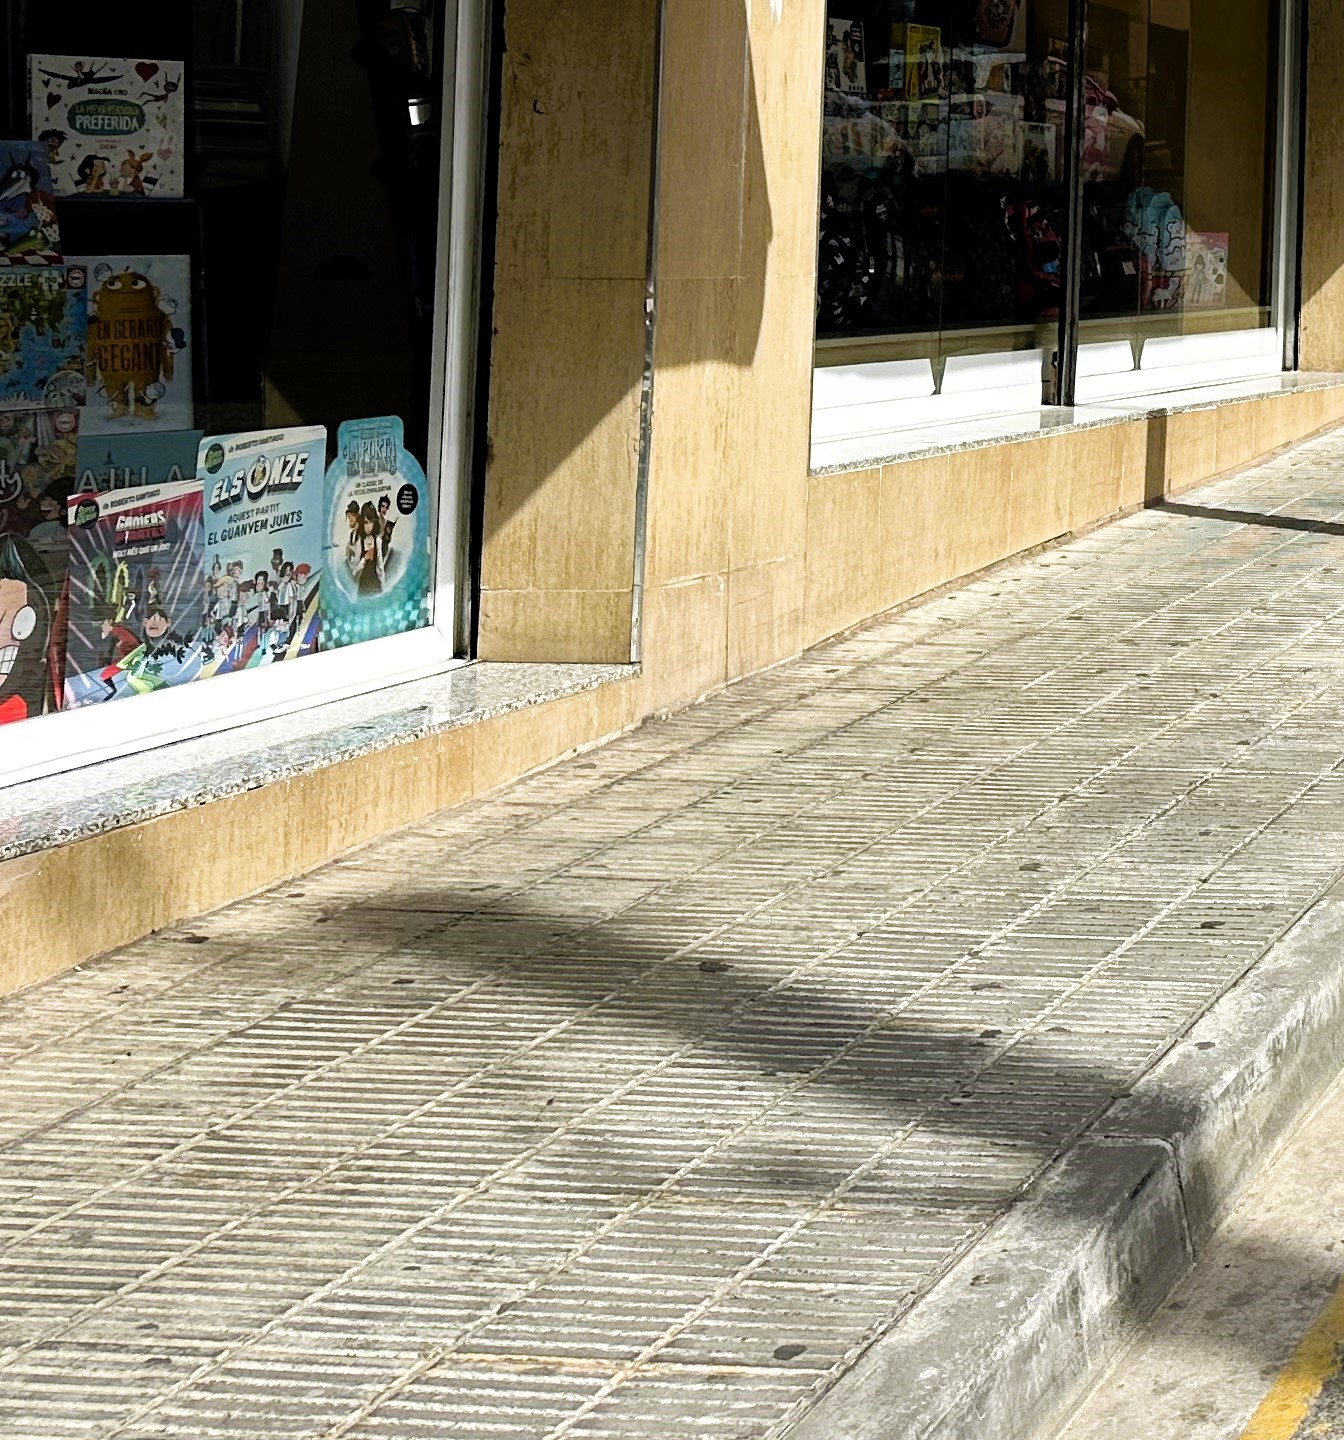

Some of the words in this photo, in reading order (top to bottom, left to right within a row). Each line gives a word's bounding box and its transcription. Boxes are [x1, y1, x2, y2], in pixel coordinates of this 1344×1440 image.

[75, 114, 140, 131] PREFERIDA
[97, 319, 110, 341] EN
[114, 318, 163, 340] GERARD
[209, 468, 245, 509] ELS
[246, 453, 310, 495] ONZE
[228, 507, 254, 524] AQUEST
[255, 503, 280, 517] PARTIT
[208, 532, 219, 546] EL
[220, 518, 268, 542] GUANYEM
[270, 510, 303, 528] JUNTS
